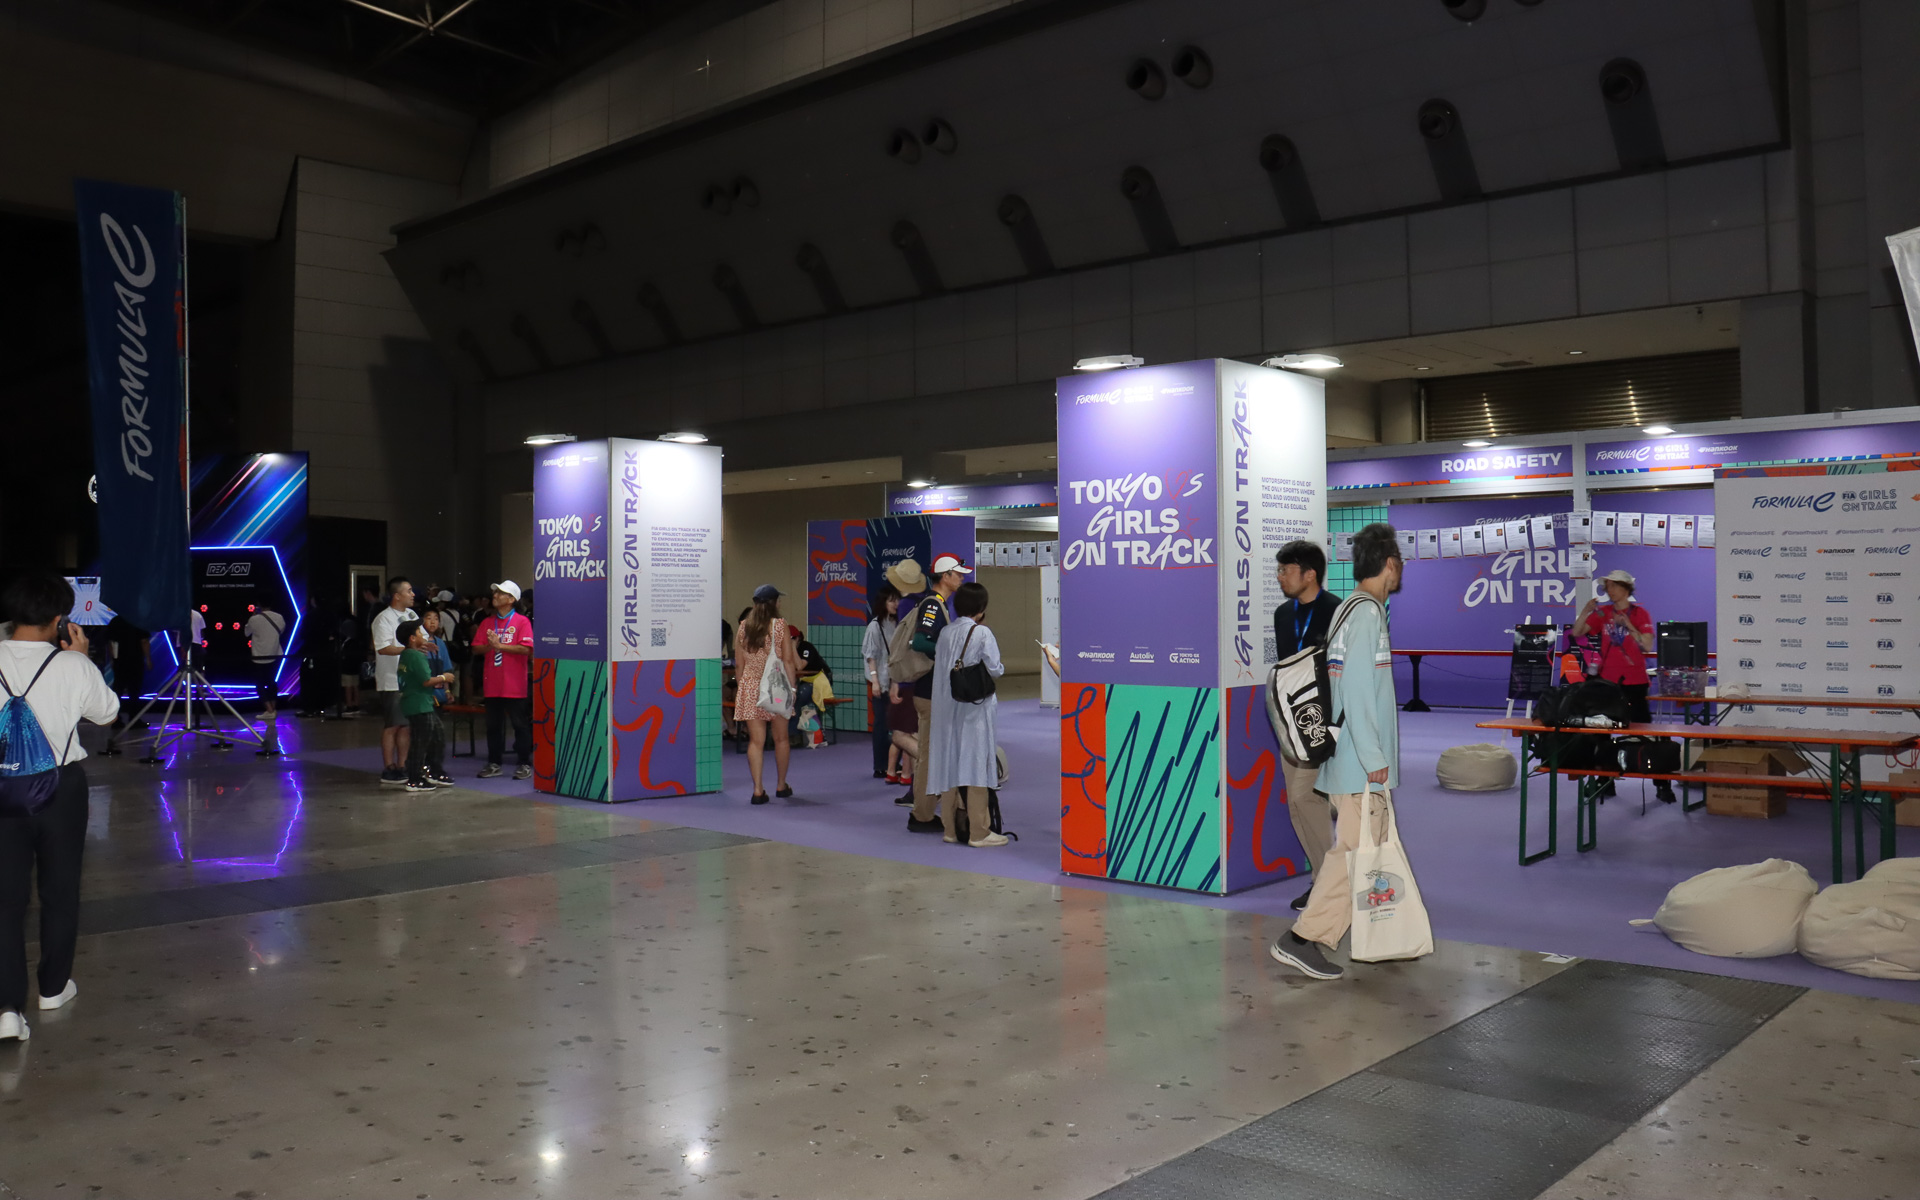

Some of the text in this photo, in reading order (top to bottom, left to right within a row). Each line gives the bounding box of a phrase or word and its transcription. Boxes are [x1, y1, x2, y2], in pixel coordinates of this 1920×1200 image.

[1442, 452, 1562, 472] ROAD SAFETY
[1070, 472, 1162, 508] TOKYO
[1262, 477, 1291, 486] MOTORSPORT
[1859, 488, 1897, 500] GIRLS
[1842, 501, 1897, 513] ON TRACK
[538, 514, 582, 539] TOKYO
[1086, 505, 1180, 541] GIRLS
[1232, 374, 1254, 668] GIRLS ON TRACK
[546, 536, 590, 561] GIRLS
[621, 450, 642, 648] GIRLS ON TRACK
[1063, 534, 1213, 571] ON TRACK
[535, 557, 606, 582] ON TRACK
[815, 570, 857, 583] ON TRACK
[822, 561, 848, 573] GIRLS
[1464, 578, 1514, 608] ON
